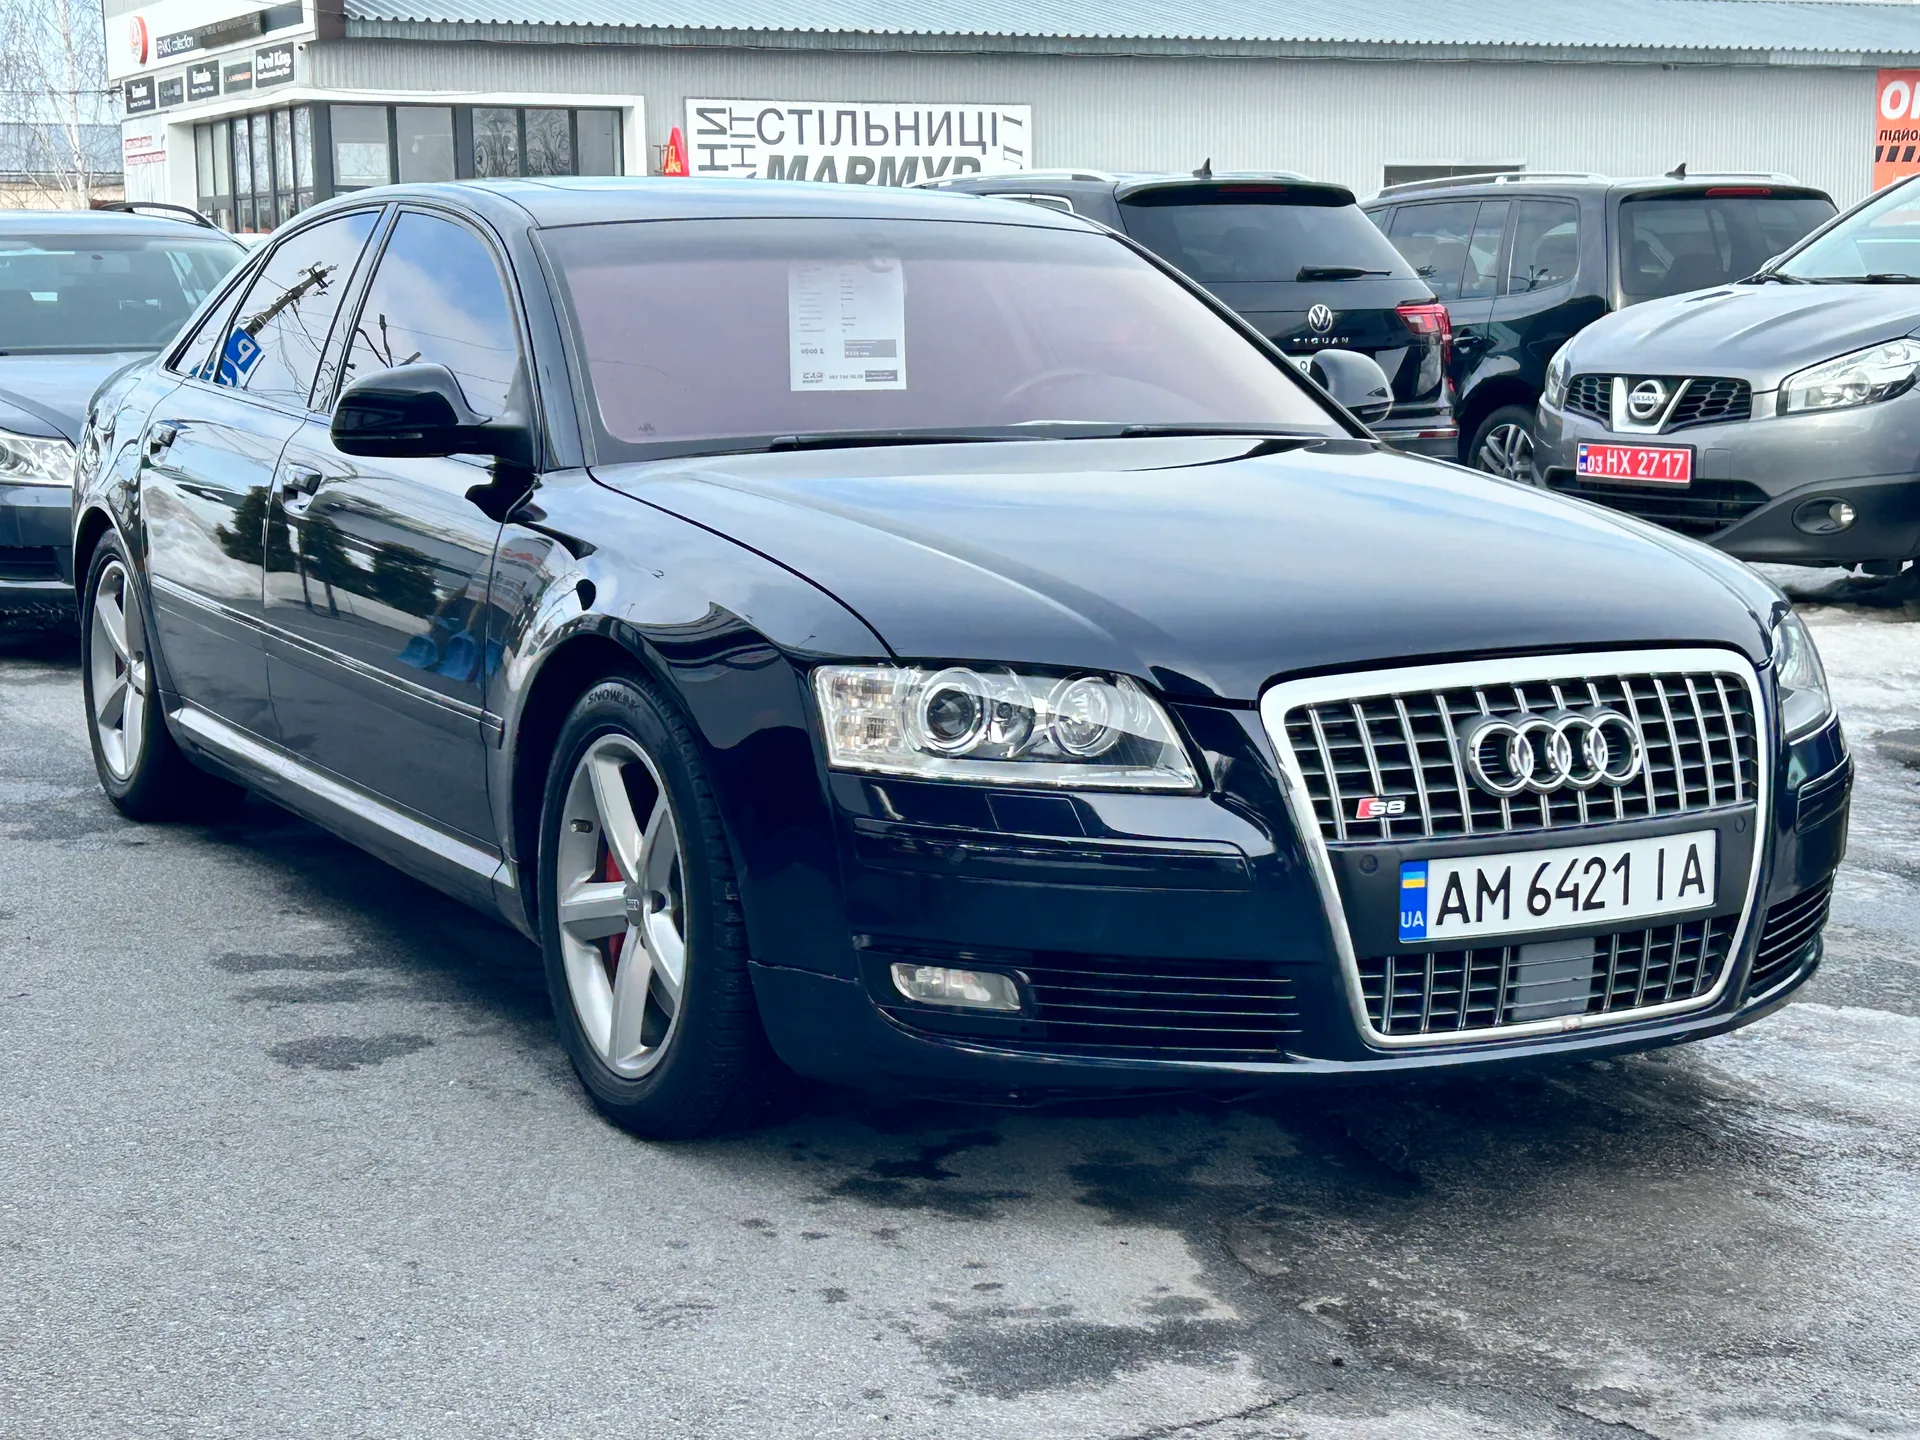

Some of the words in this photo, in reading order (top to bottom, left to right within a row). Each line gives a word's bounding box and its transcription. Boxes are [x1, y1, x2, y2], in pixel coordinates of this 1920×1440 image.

[729, 107, 757, 178] НІТ
[757, 108, 997, 155] СТІЛЬНИЦІ
[1879, 127, 1920, 143] ПІДЙО
[1587, 455, 1603, 473] 03
[1606, 449, 1631, 474] HX
[1637, 451, 1684, 477] 2717
[1368, 800, 1406, 816] S8
[1435, 866, 1511, 926] AM
[1527, 852, 1632, 917] 6421
[1656, 843, 1706, 901] IA
[1401, 910, 1424, 928] UA
